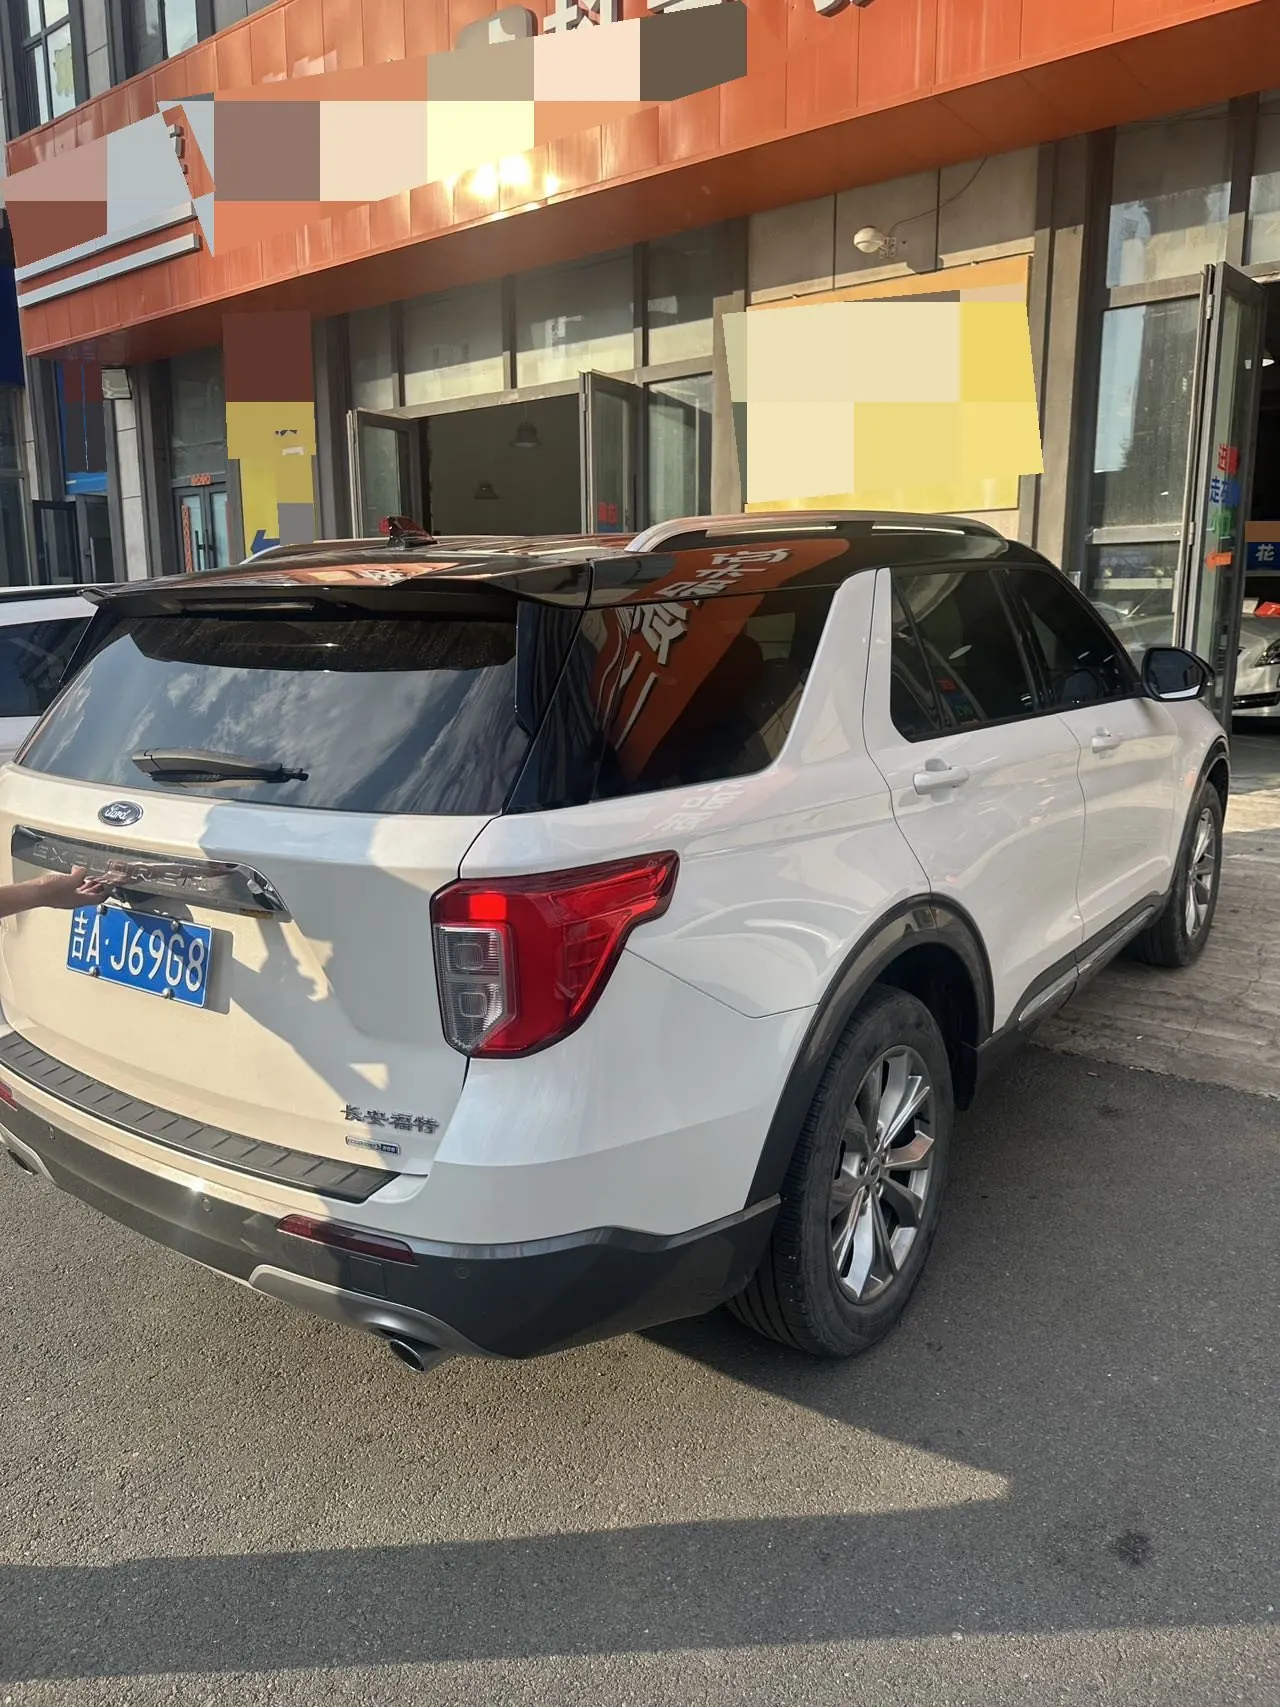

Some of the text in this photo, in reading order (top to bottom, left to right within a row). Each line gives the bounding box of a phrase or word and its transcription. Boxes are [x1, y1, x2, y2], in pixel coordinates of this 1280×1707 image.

[1255, 543, 1275, 562] 花
[102, 803, 132, 821] Ford
[340, 1104, 440, 1134] 长安福特
